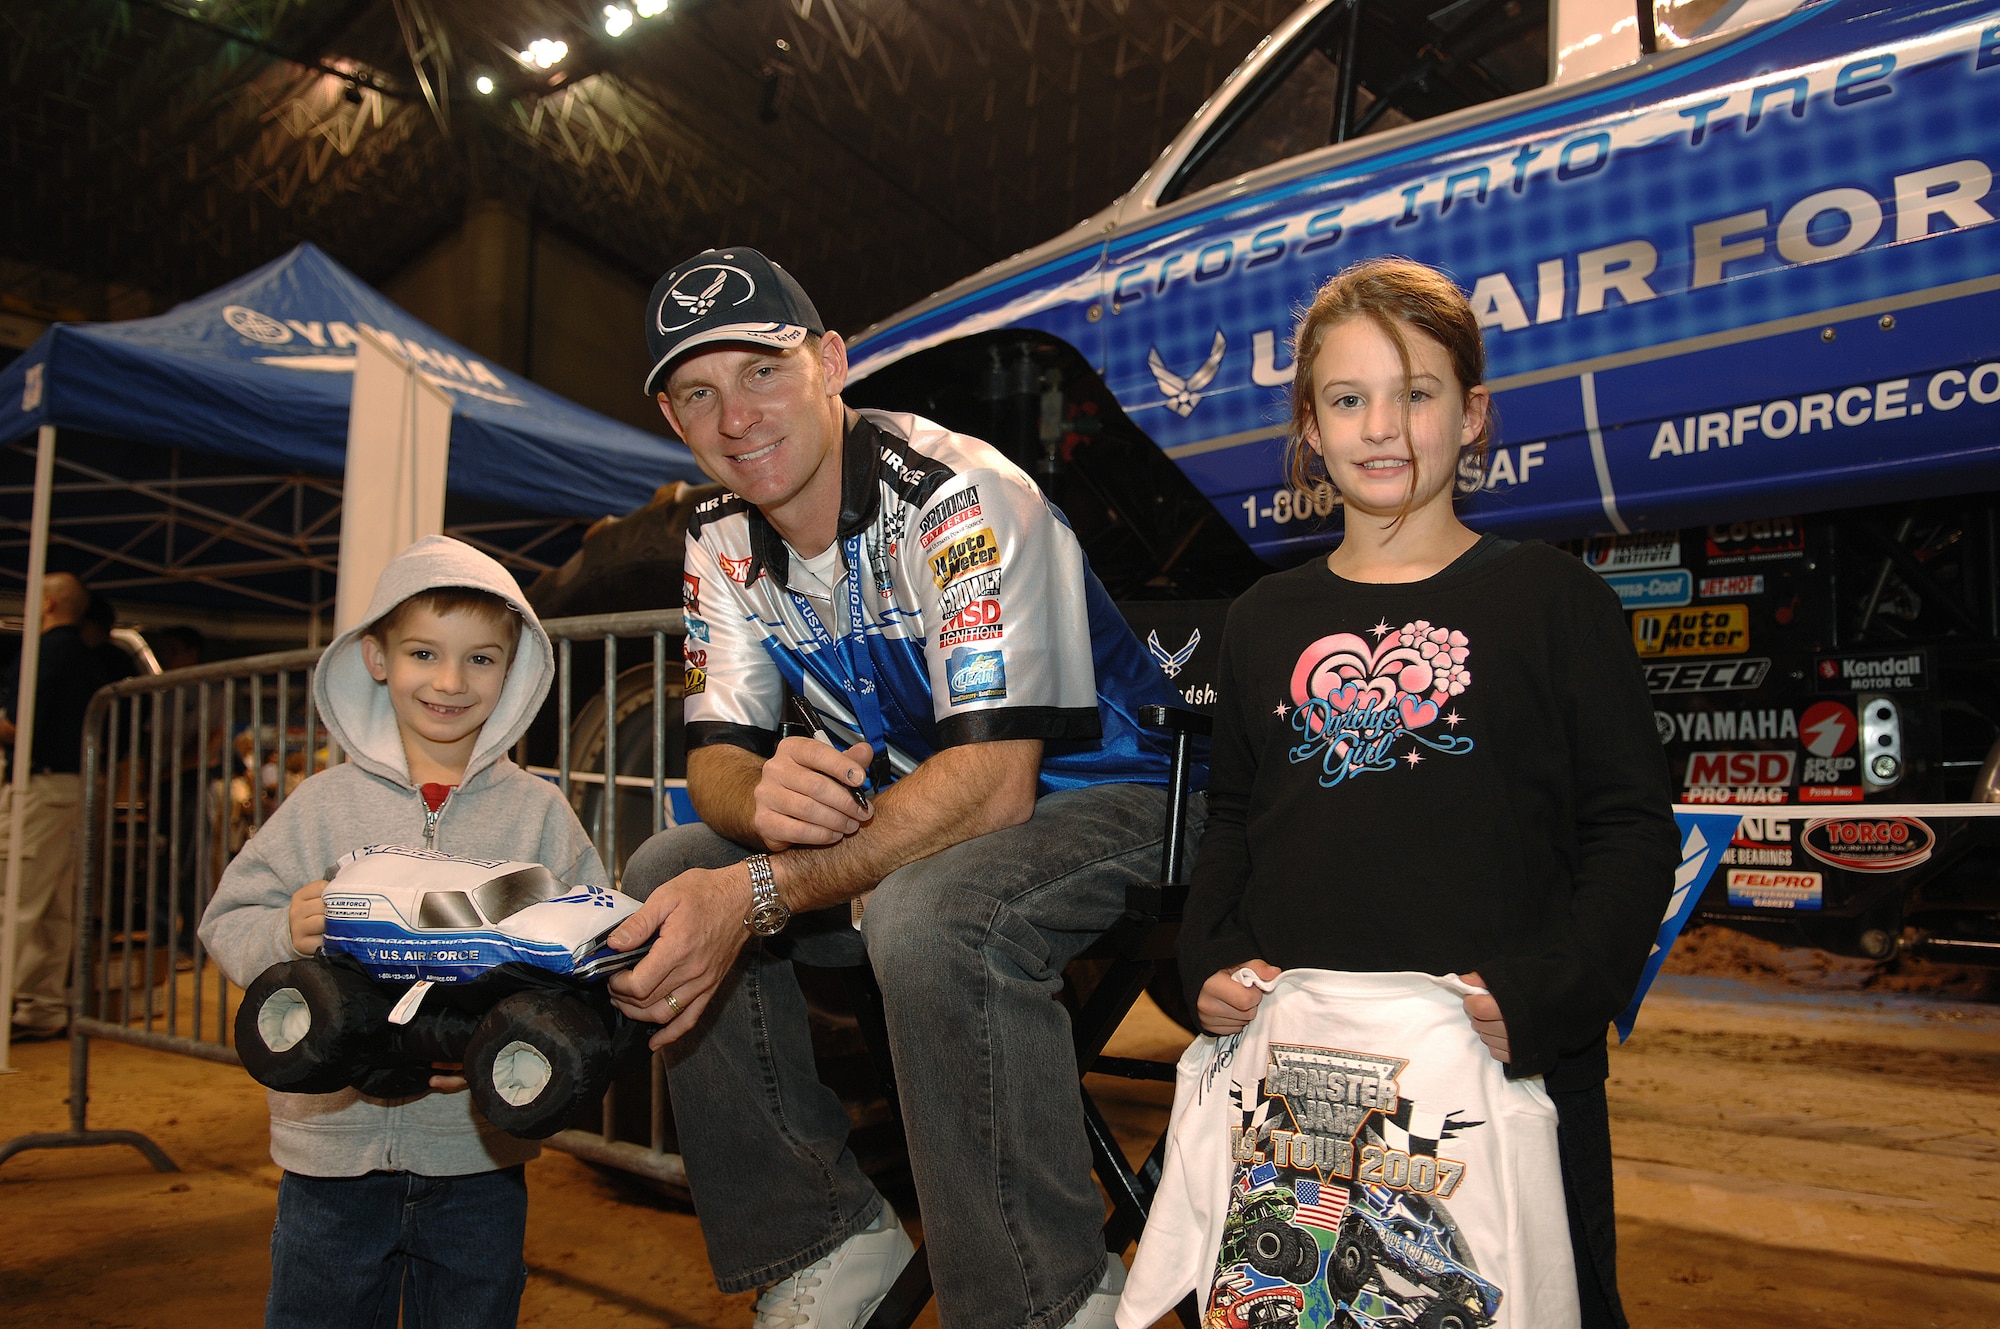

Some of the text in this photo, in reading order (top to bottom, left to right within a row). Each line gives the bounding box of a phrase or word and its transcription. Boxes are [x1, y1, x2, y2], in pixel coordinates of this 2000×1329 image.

[919, 484, 979, 539] OPTIMA
[920, 504, 982, 549] BATTERIES
[947, 534, 986, 564] Auto
[947, 546, 998, 581] Meter
[941, 599, 1002, 632] MSD
[1667, 612, 1730, 632] Auto
[942, 626, 1003, 648] IGNITION
[1661, 631, 1743, 653] Meter
[1646, 661, 1762, 690] SECO
[1842, 656, 1921, 678] Kendall
[1850, 676, 1914, 690] MOTOR OIL
[1291, 696, 1399, 743] Daddy's
[1676, 708, 1799, 742] YAMAHA
[1690, 753, 1790, 786] MSD
[1803, 769, 1841, 784] PRO
[1805, 757, 1857, 772] SPEED
[1826, 821, 1910, 845] TORCO
[1738, 848, 1793, 867] BEARINGS
[380, 949, 480, 962] U.S. AIR FORCE
[1265, 1064, 1399, 1114] MONSTER
[1296, 1098, 1365, 1138] JAM
[1270, 1129, 1355, 1180] TOUR
[1359, 1145, 1467, 1199] 2007
[1378, 1225, 1446, 1273] BLUE THUNDER
